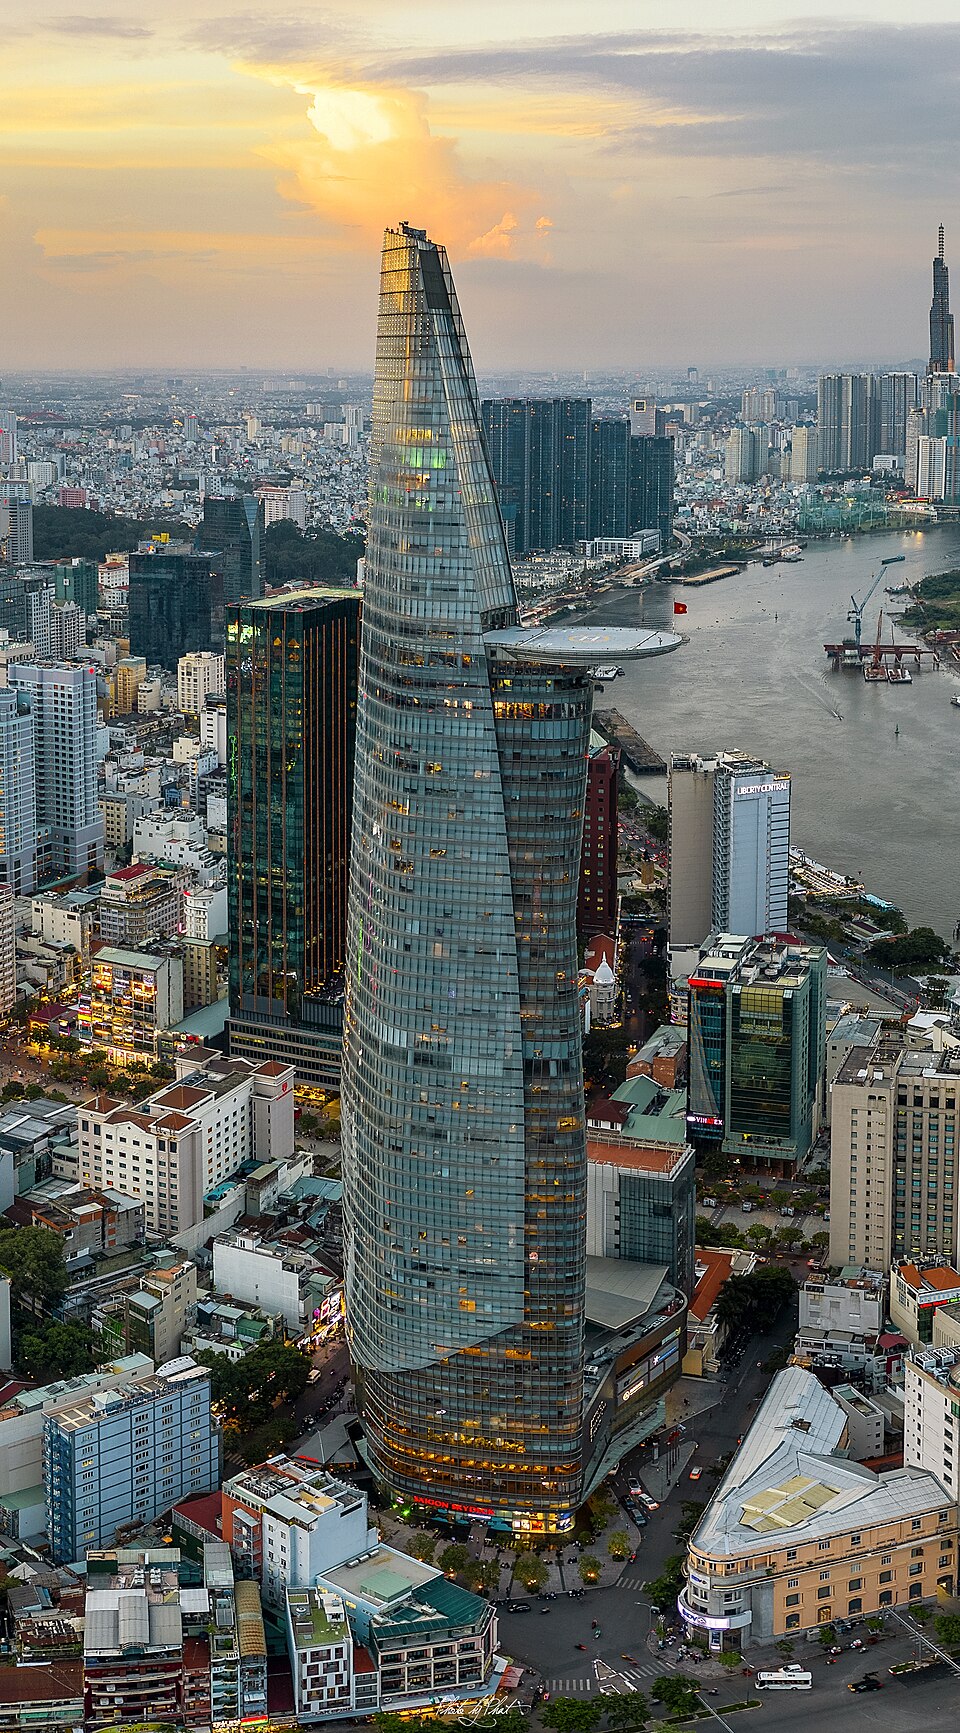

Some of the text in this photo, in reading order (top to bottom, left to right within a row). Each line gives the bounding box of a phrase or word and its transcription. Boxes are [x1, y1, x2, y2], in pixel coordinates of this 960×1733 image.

[737, 782, 788, 795] LIBERTY CENTRAL
[413, 1496, 449, 1508] SAIGON
[452, 1504, 495, 1515] SKYDECK
